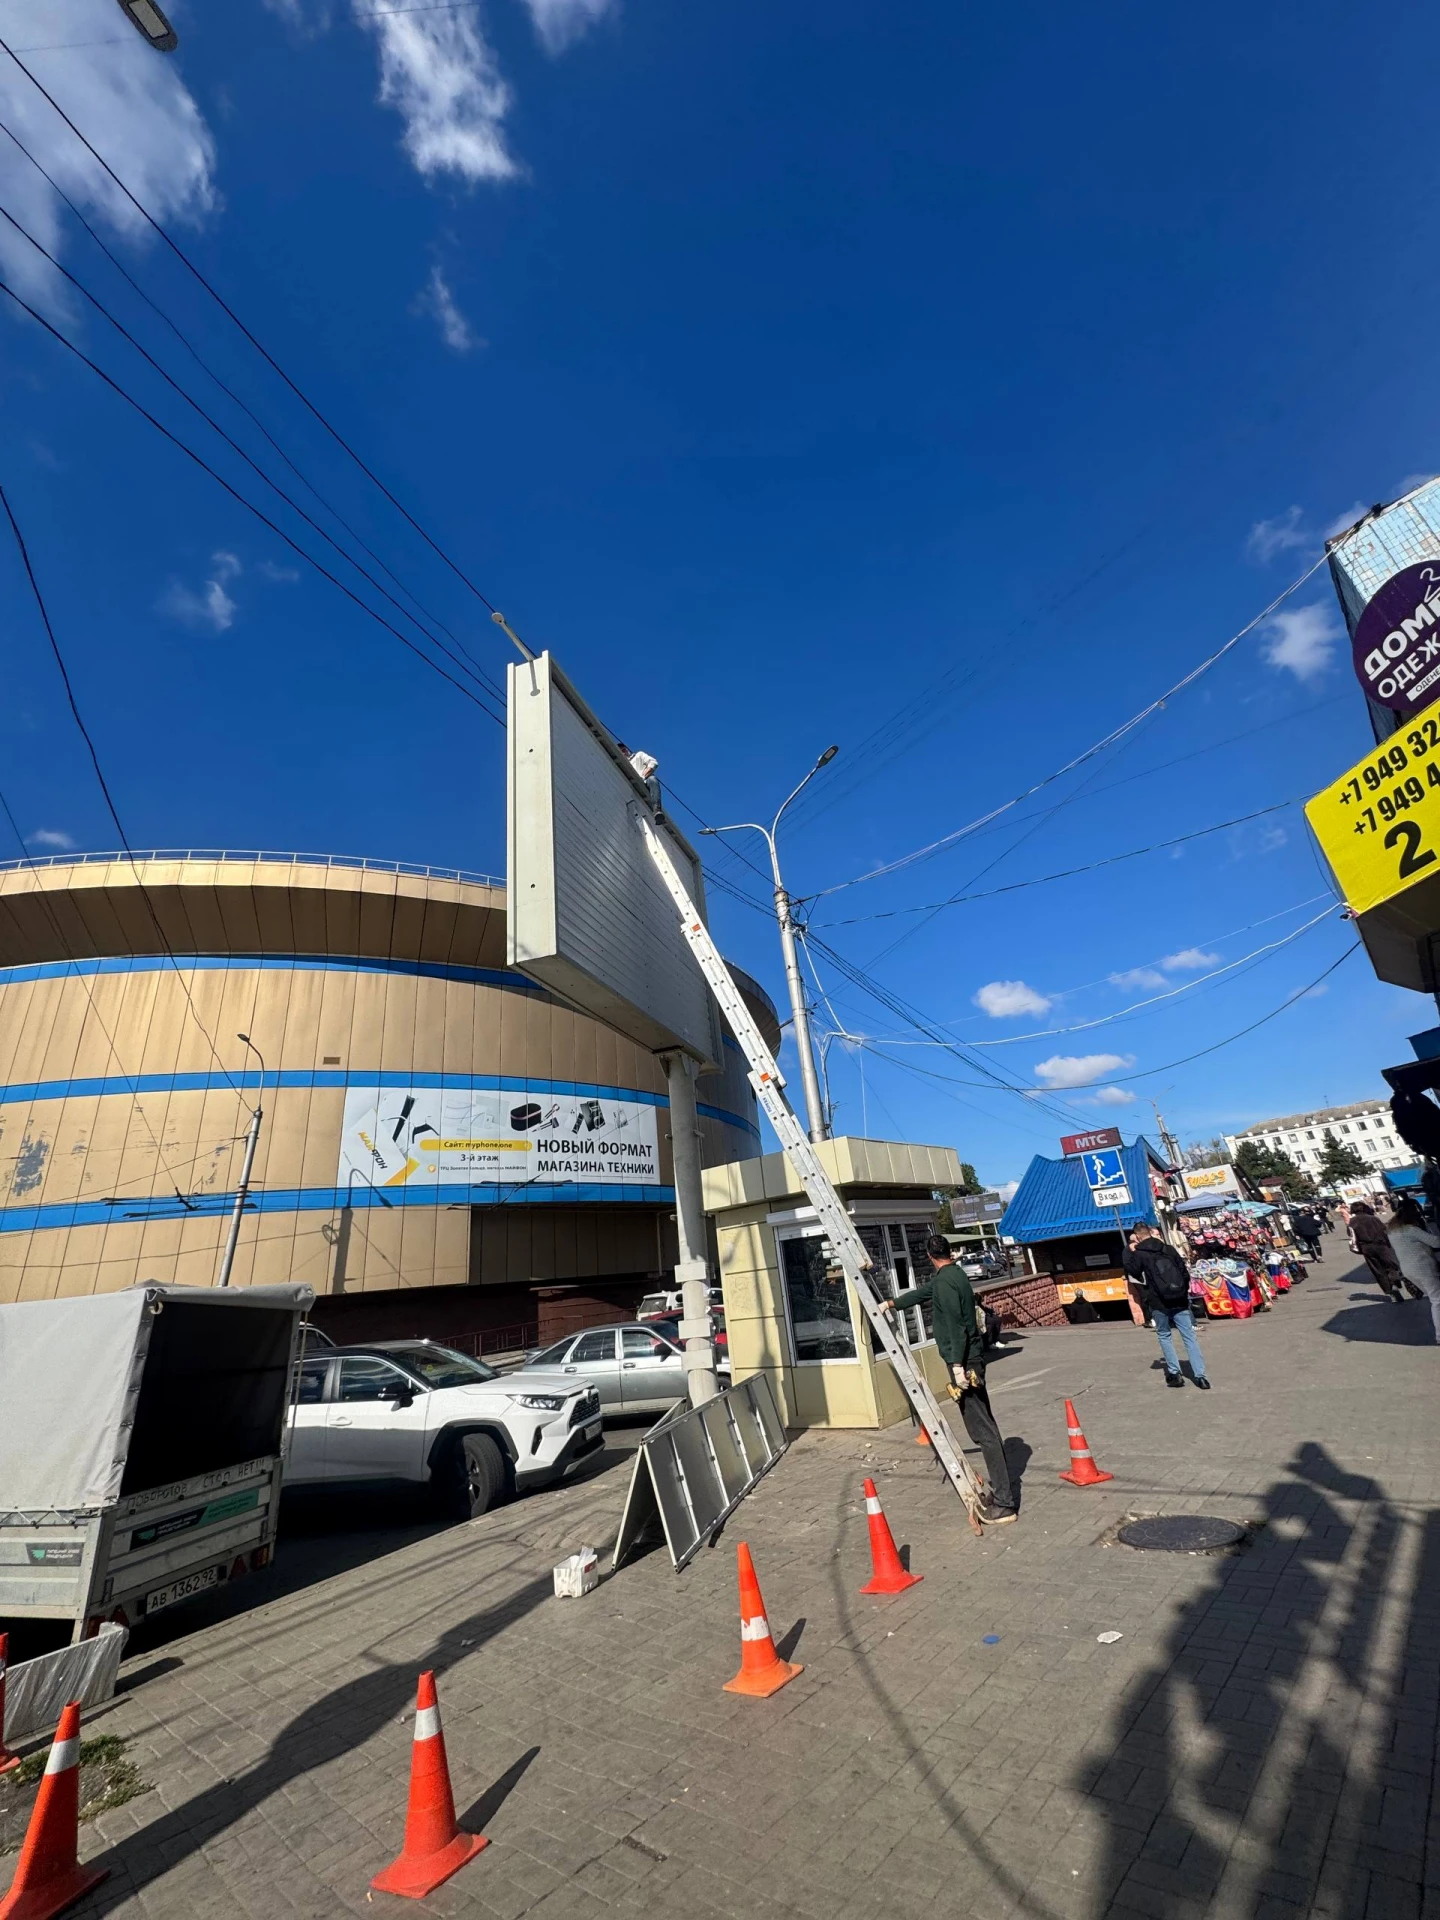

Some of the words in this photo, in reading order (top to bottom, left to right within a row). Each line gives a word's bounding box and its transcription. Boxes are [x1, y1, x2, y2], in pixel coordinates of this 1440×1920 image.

[1339, 777, 1362, 805] +7
[1362, 745, 1408, 791] 949
[1406, 711, 1440, 757] 32
[1353, 806, 1377, 835] +7
[1377, 776, 1425, 822] 949
[1384, 820, 1438, 880] 2
[537, 1138, 595, 1154] НОВЫЙ
[598, 1141, 652, 1157] ФОРМАТ
[1075, 1133, 1108, 1149] МТС
[460, 1153, 475, 1161] 3-й
[537, 1160, 605, 1172] МАГАЗИНА
[607, 1162, 654, 1174] ТЕХНИКИ
[171, 1575, 201, 1600] 1362
[202, 1569, 214, 1583] 92
